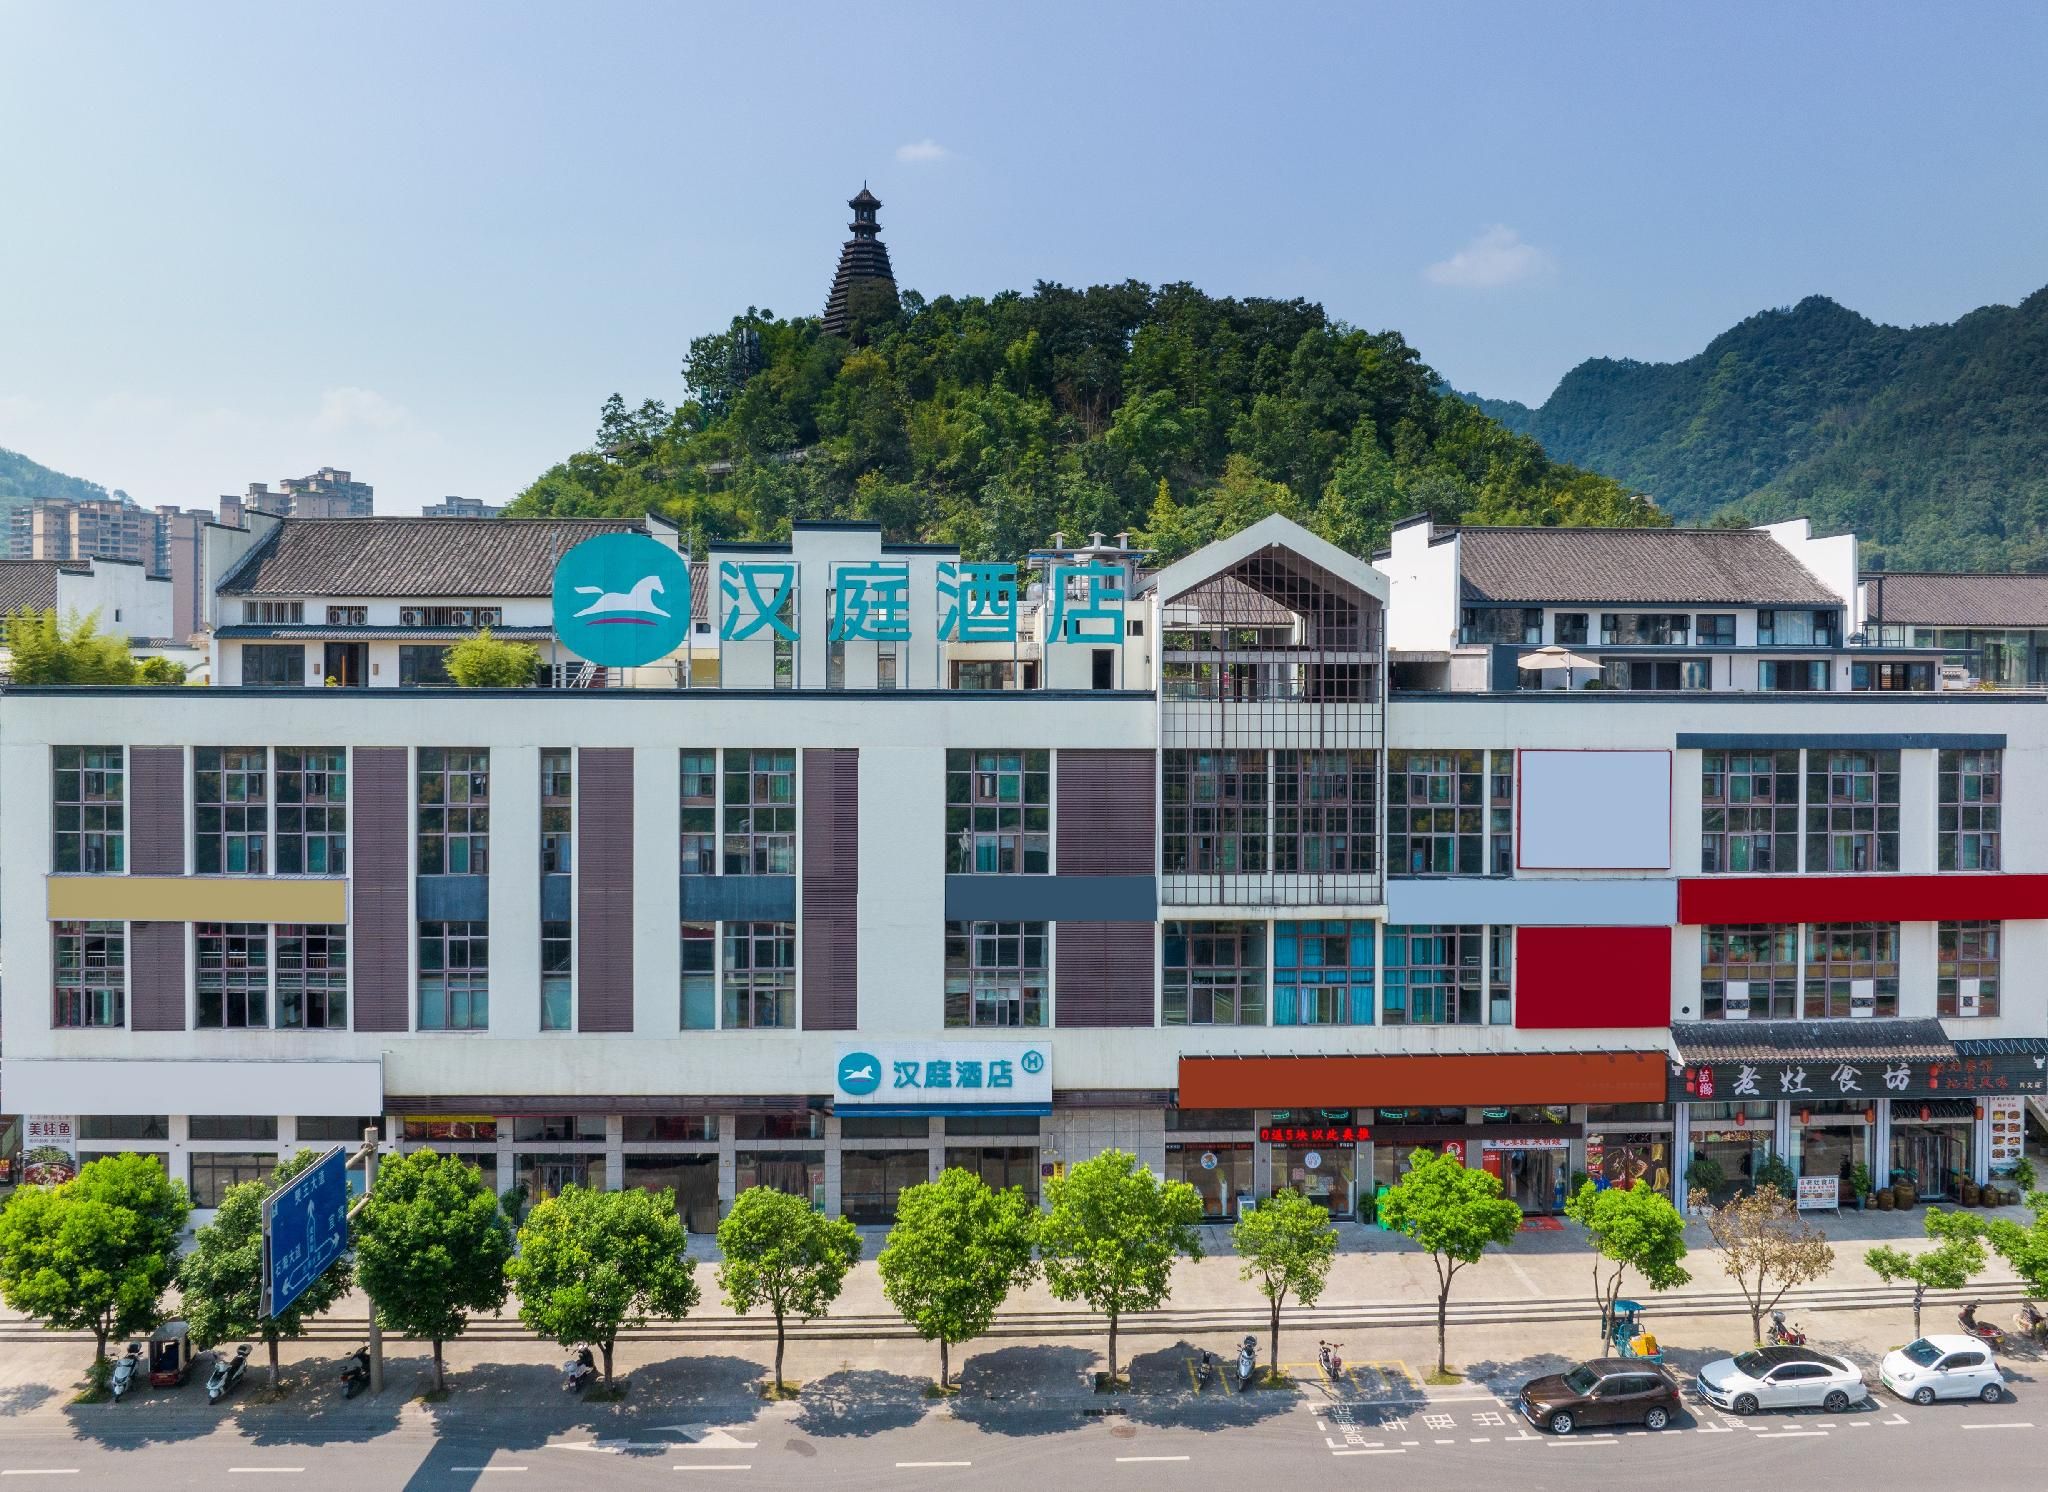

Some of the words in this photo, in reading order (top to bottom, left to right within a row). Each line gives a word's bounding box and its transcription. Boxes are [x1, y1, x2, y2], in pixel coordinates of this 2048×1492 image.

[720, 561, 1125, 645] 汉庭酒店
[893, 1060, 1013, 1089] 汉庭酒店
[29, 1123, 71, 1136] 美蛙鱼
